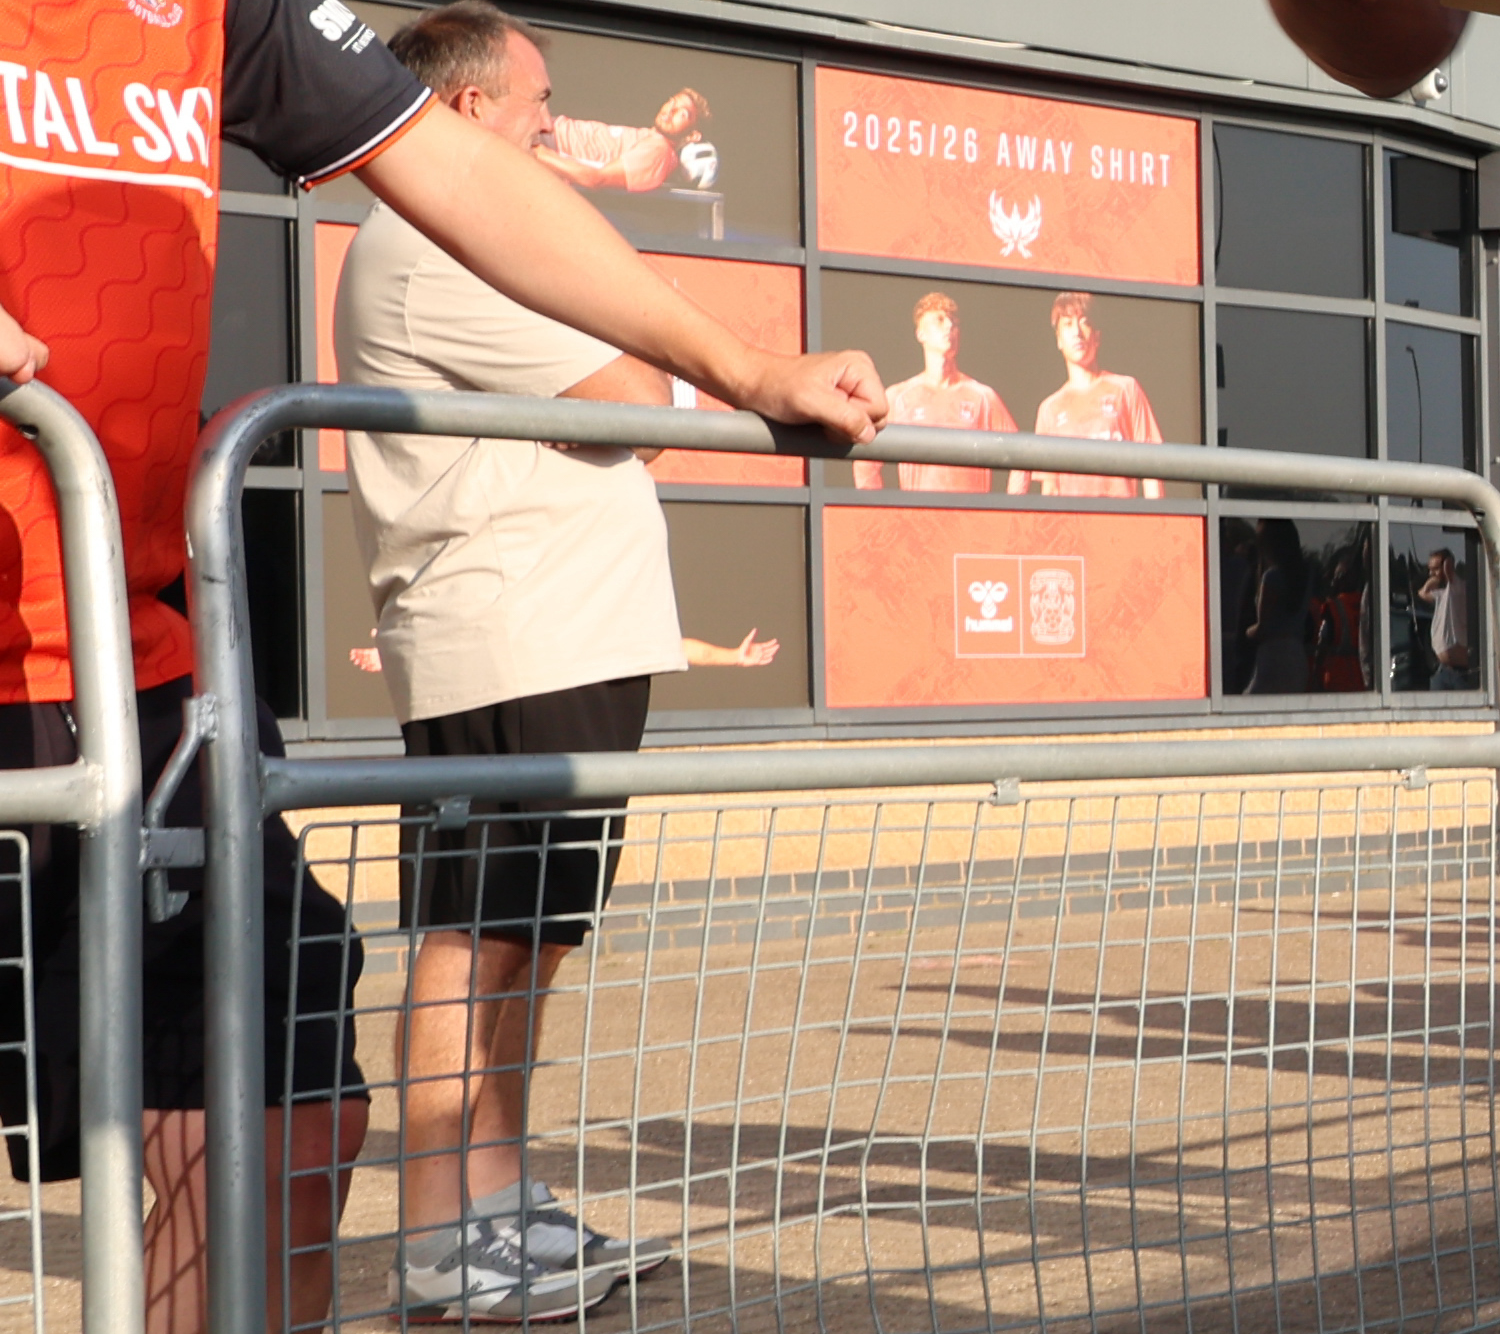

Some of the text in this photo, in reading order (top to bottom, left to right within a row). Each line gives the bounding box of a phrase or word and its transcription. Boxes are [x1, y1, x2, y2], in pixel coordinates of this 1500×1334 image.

[843, 111, 1171, 188] 2025/26 AWAY SHIRT
